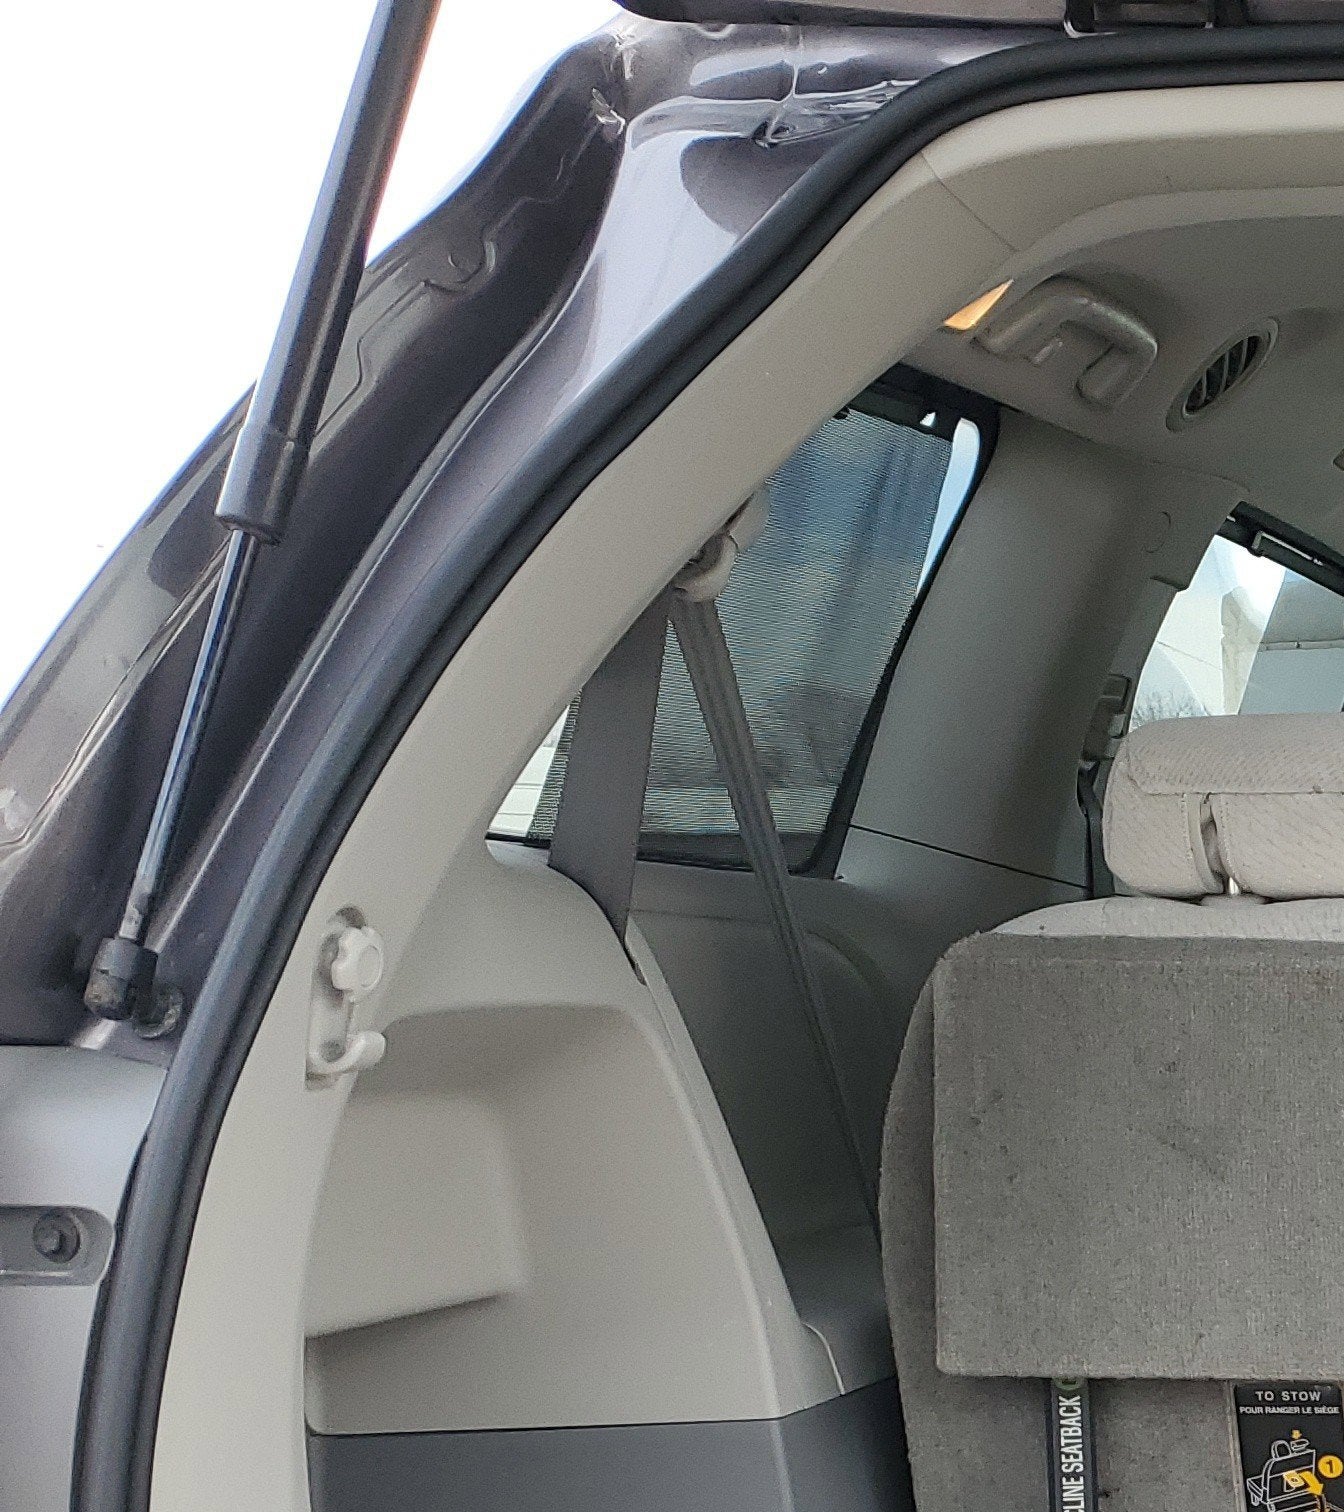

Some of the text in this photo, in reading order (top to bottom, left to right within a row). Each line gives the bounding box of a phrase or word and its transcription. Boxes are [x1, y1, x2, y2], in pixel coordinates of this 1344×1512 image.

[1255, 1390, 1321, 1401] TO STOW
[1239, 1406, 1264, 1414] POUR
[1265, 1406, 1300, 1414] RANGER
[1302, 1406, 1313, 1414] LE
[1058, 1394, 1084, 1473] SEATBACK
